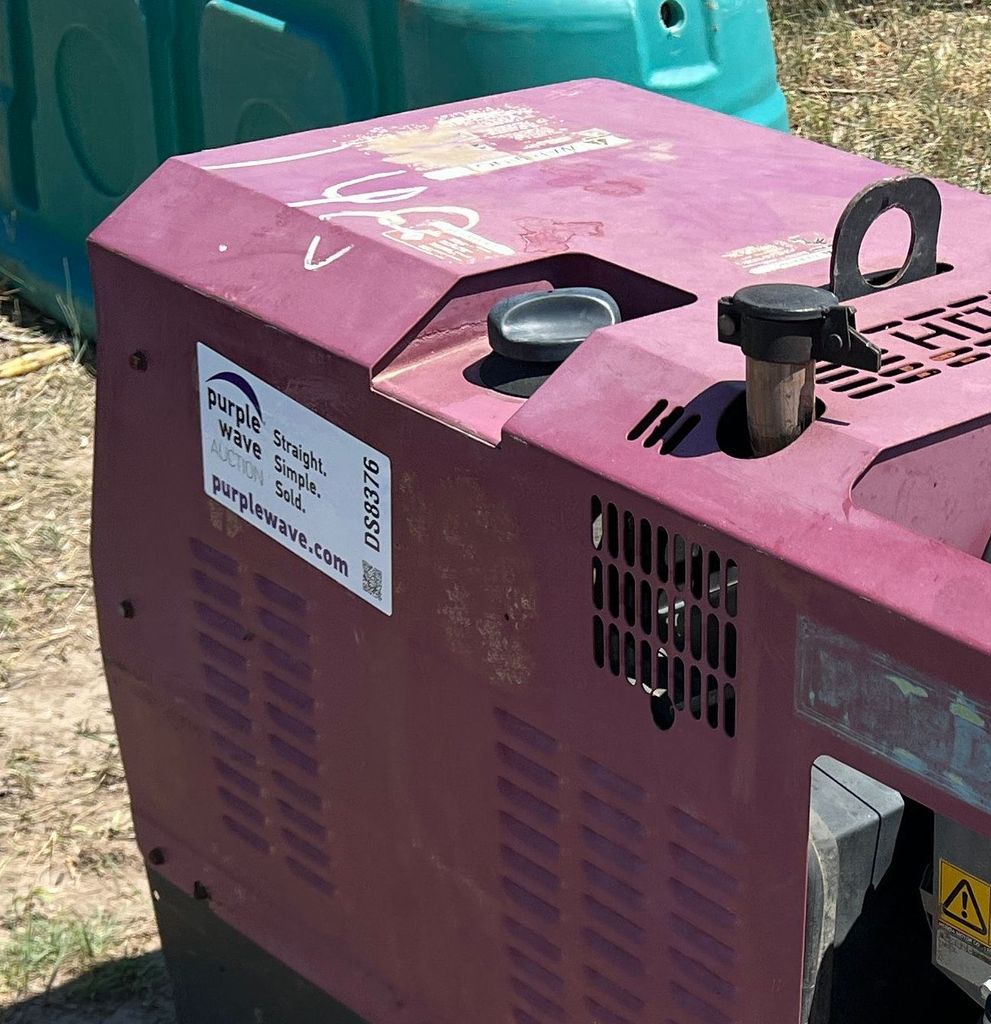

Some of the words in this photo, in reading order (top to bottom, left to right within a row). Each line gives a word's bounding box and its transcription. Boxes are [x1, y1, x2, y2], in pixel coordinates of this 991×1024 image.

[207, 387, 261, 433] purple
[210, 439, 264, 486] AUCTION
[218, 419, 262, 460] wave
[273, 429, 327, 477] Straight.
[274, 455, 321, 499] Simple.
[275, 480, 306, 513] Sold.
[212, 474, 349, 577] purplewave.com
[363, 457, 381, 552] DS8376
